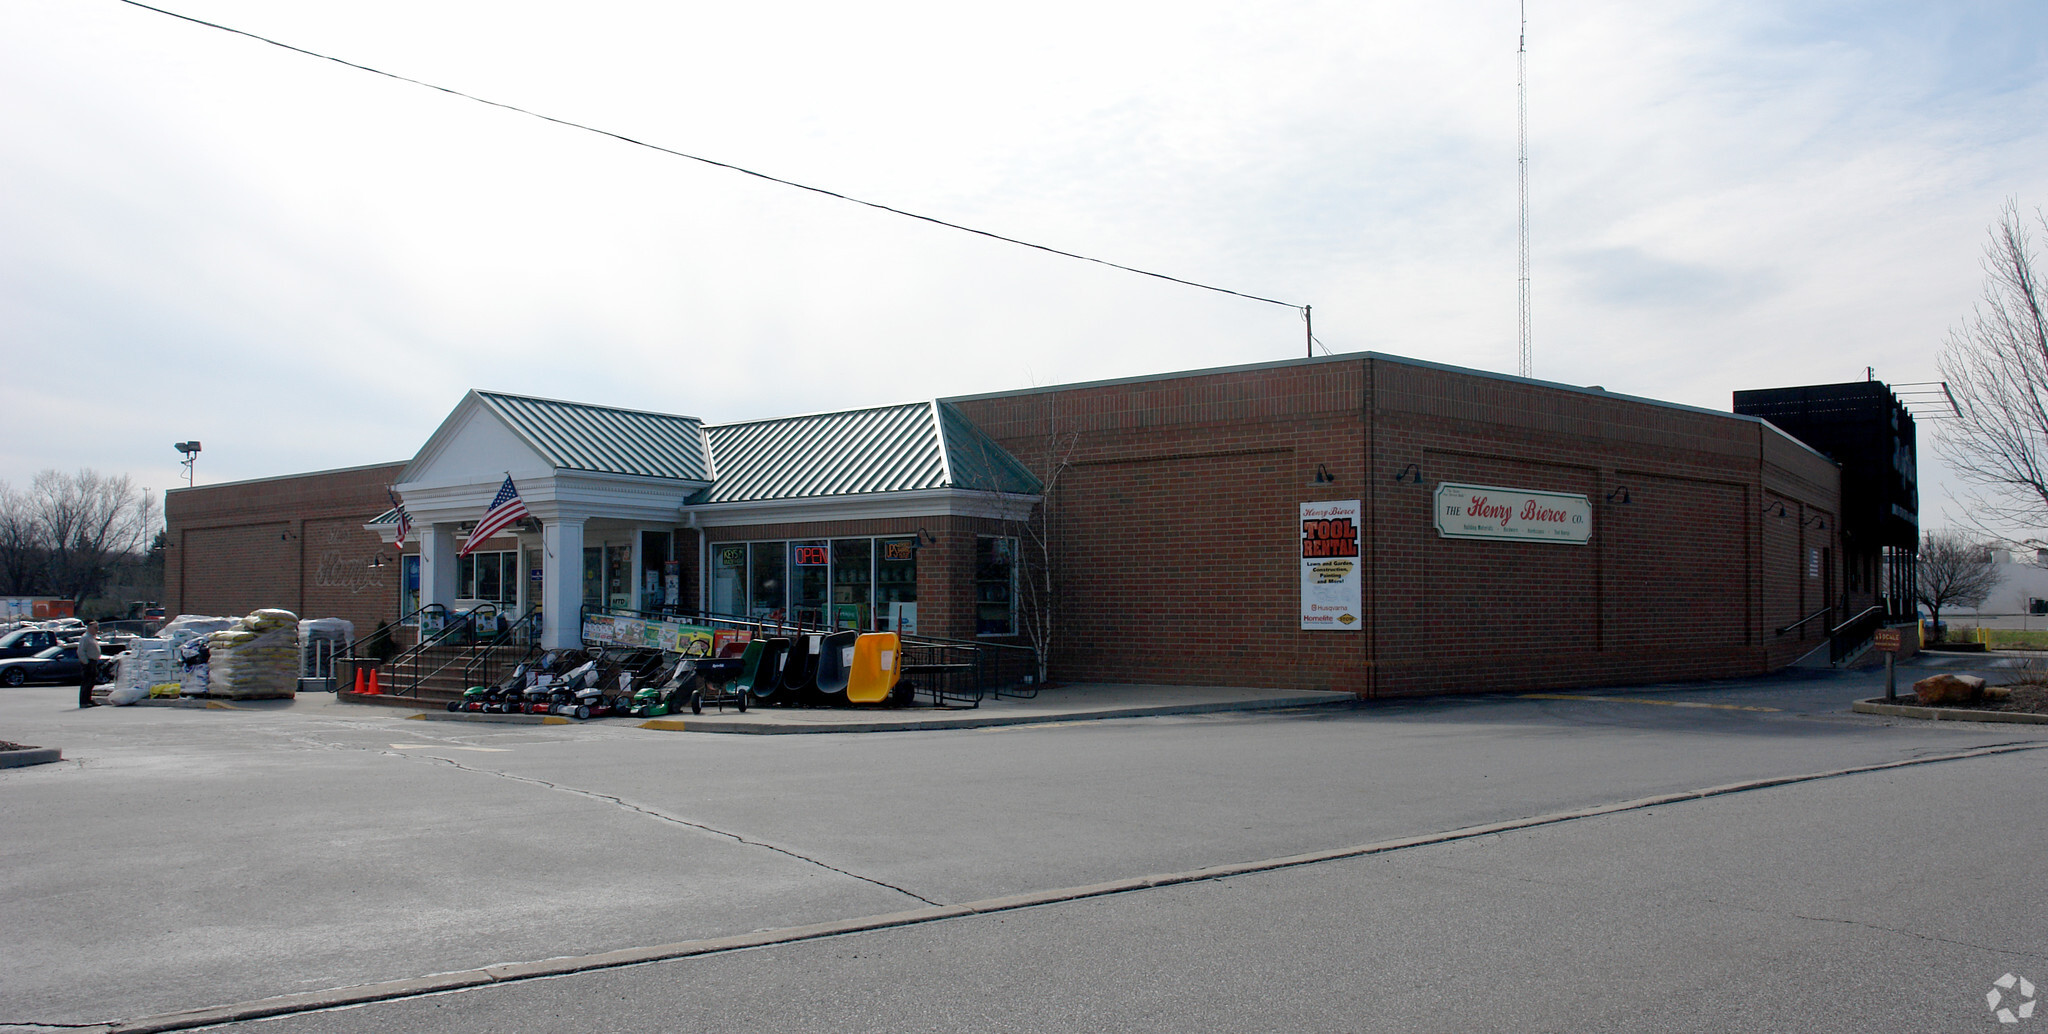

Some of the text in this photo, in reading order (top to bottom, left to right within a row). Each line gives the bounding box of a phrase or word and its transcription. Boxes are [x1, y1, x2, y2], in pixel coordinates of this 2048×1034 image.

[1302, 506, 1355, 518] Henry Bierce
[1446, 495, 1584, 527] THE Henry Bierce CO.
[1303, 519, 1356, 540] TOOL
[796, 547, 829, 564] OPEN
[1303, 539, 1358, 557] RENTAL
[1317, 604, 1348, 612] Husqvarna
